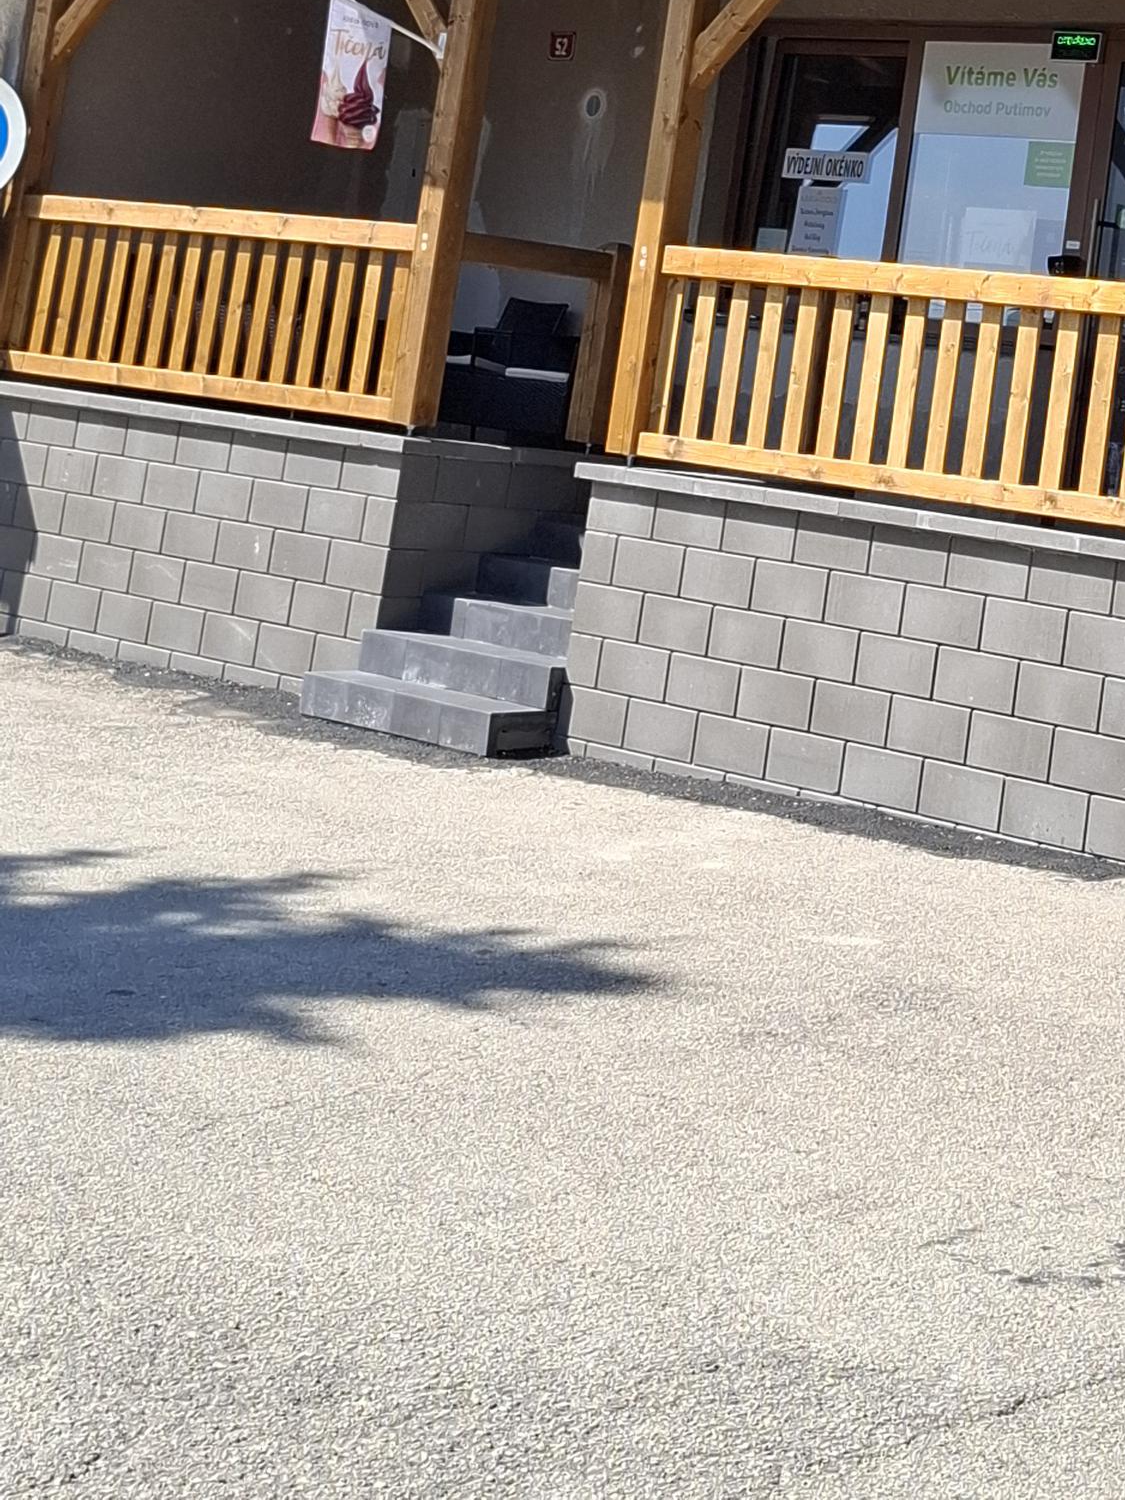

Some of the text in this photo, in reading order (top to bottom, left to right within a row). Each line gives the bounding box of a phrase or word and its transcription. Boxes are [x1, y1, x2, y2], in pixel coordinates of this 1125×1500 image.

[555, 37, 568, 56] 52
[946, 66, 1058, 88] Vítáme Vás
[943, 100, 1051, 118] Obchod Putimov
[786, 152, 864, 178] VÝDEJNÍ OKÉNKO
